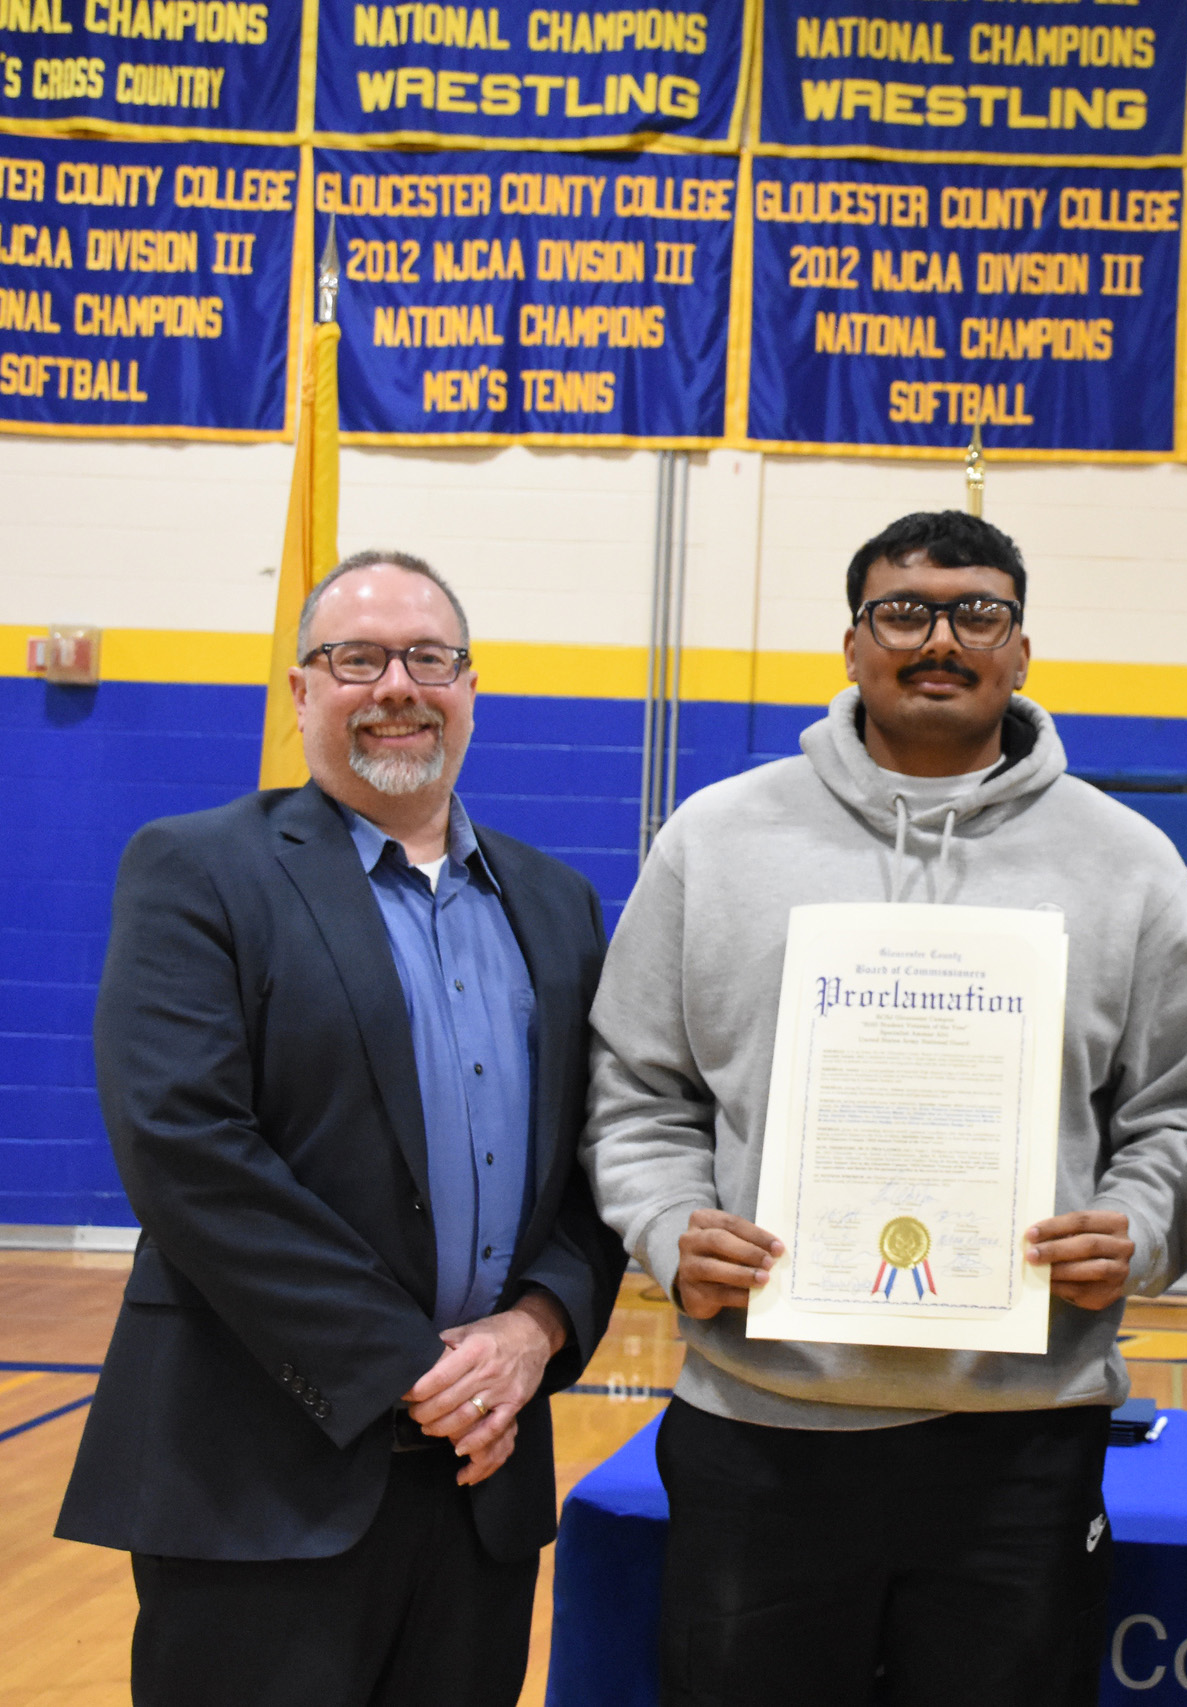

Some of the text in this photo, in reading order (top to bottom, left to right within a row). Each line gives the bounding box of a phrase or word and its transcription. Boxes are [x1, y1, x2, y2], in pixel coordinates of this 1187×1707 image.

[85, 0, 268, 44] CHAMPIONS
[355, 3, 707, 54] NATIONAL CHAMPIONS
[797, 17, 1155, 68] NATIONAL CHAMPIONS
[33, 57, 105, 99] CROSS
[116, 63, 224, 108] COUNTRY
[358, 67, 700, 118] WRESTLING
[802, 78, 1147, 130] WRESTLING
[56, 162, 163, 207] COUNTY
[175, 165, 296, 210] COLLEGE
[317, 173, 734, 221] GLOUCESTER COUNTY COLLEGE
[756, 178, 1179, 231] GLOUCESTER COUNTY COLLEGE
[86, 229, 197, 272] DIVISION
[213, 232, 256, 274] III
[347, 239, 696, 284] 2012 NJCAA DIVISION III
[790, 245, 1143, 296] 2012 NJCAA DIVISION III
[75, 293, 223, 338] CHAMPIONS
[374, 304, 665, 348] NATIONAL CHAMPIONS
[815, 311, 1113, 360] NATIONAL CHAMPIONS
[0, 353, 147, 402] SOFTBALL
[424, 365, 615, 413] MEN'S TENNIS
[889, 380, 1033, 425] SOFTBALL
[815, 976, 1024, 1017] Proclamation
